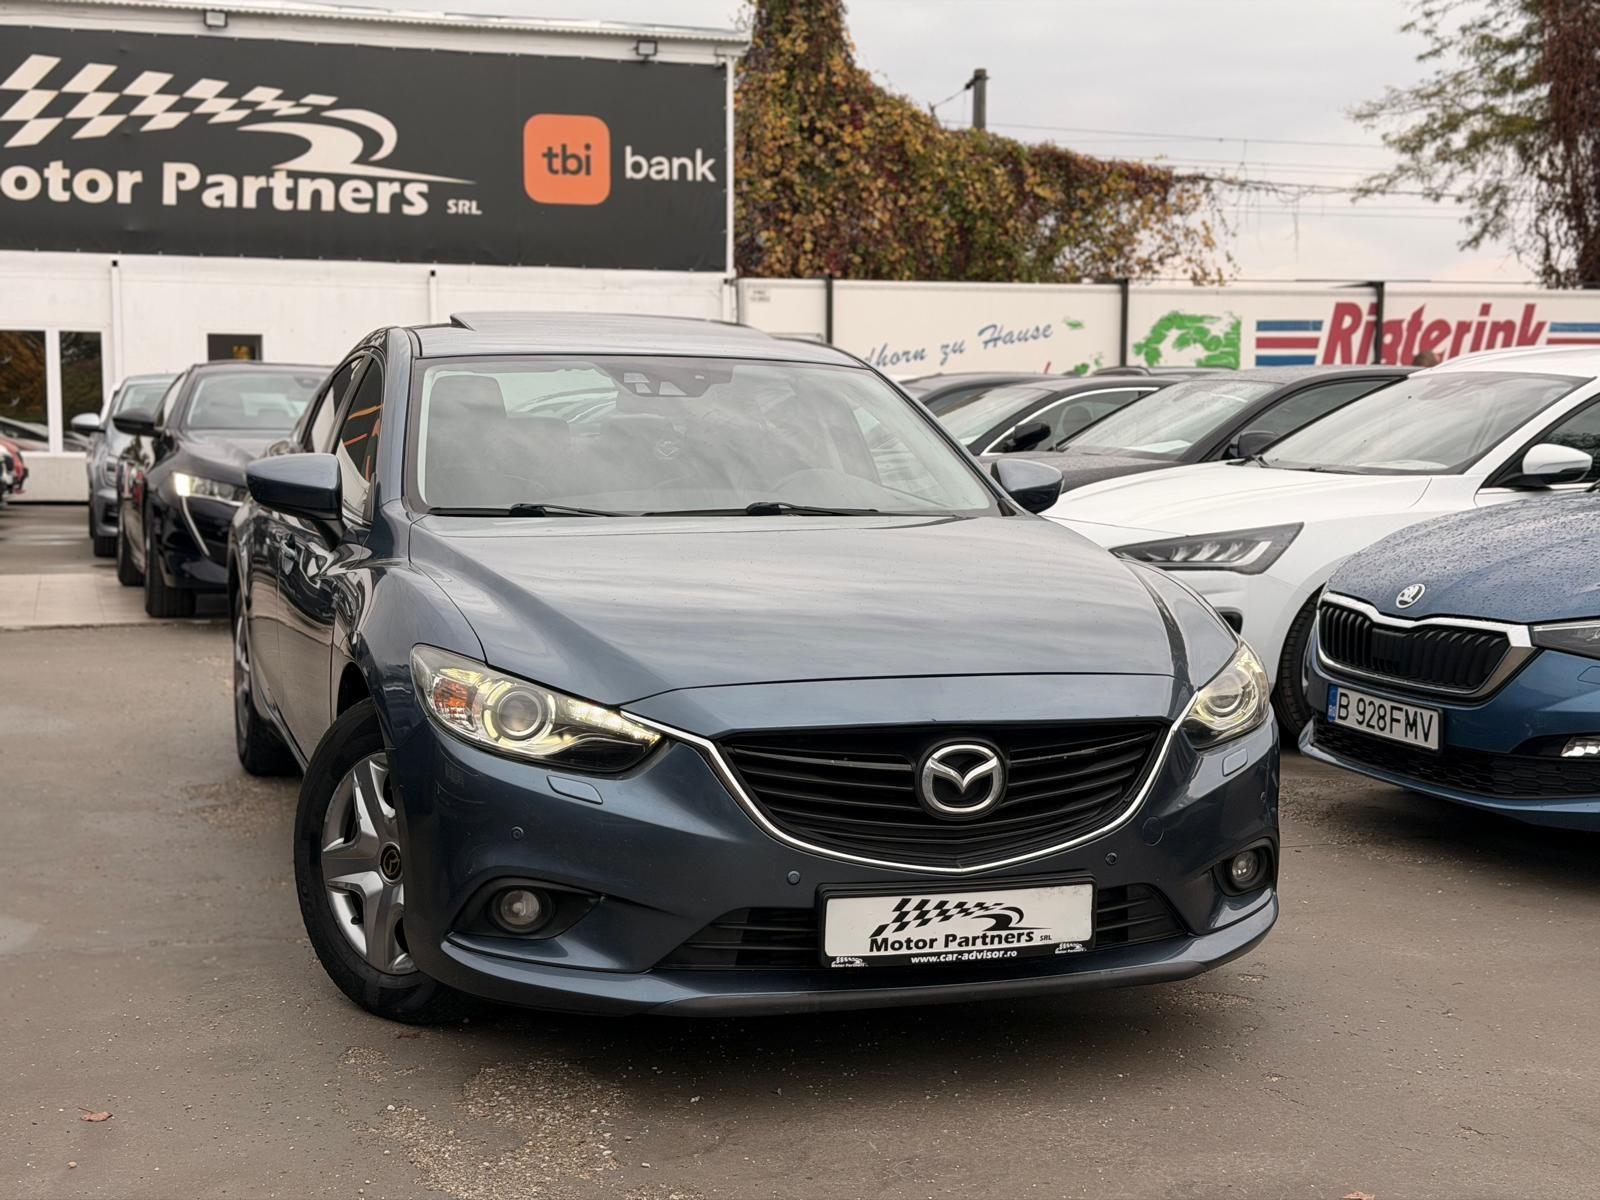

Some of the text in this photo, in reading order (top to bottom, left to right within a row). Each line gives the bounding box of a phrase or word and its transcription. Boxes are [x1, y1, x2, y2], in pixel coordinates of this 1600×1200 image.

[541, 143, 717, 183] tbi bank
[162, 161, 430, 216] Partners
[446, 198, 483, 216] SRL
[939, 339, 967, 367] zu
[977, 323, 1054, 350] Hause
[1337, 692, 1351, 721] B
[868, 930, 1053, 953] Motor Partners SRL
[910, 949, 1018, 965] www.car-advisor.ro
